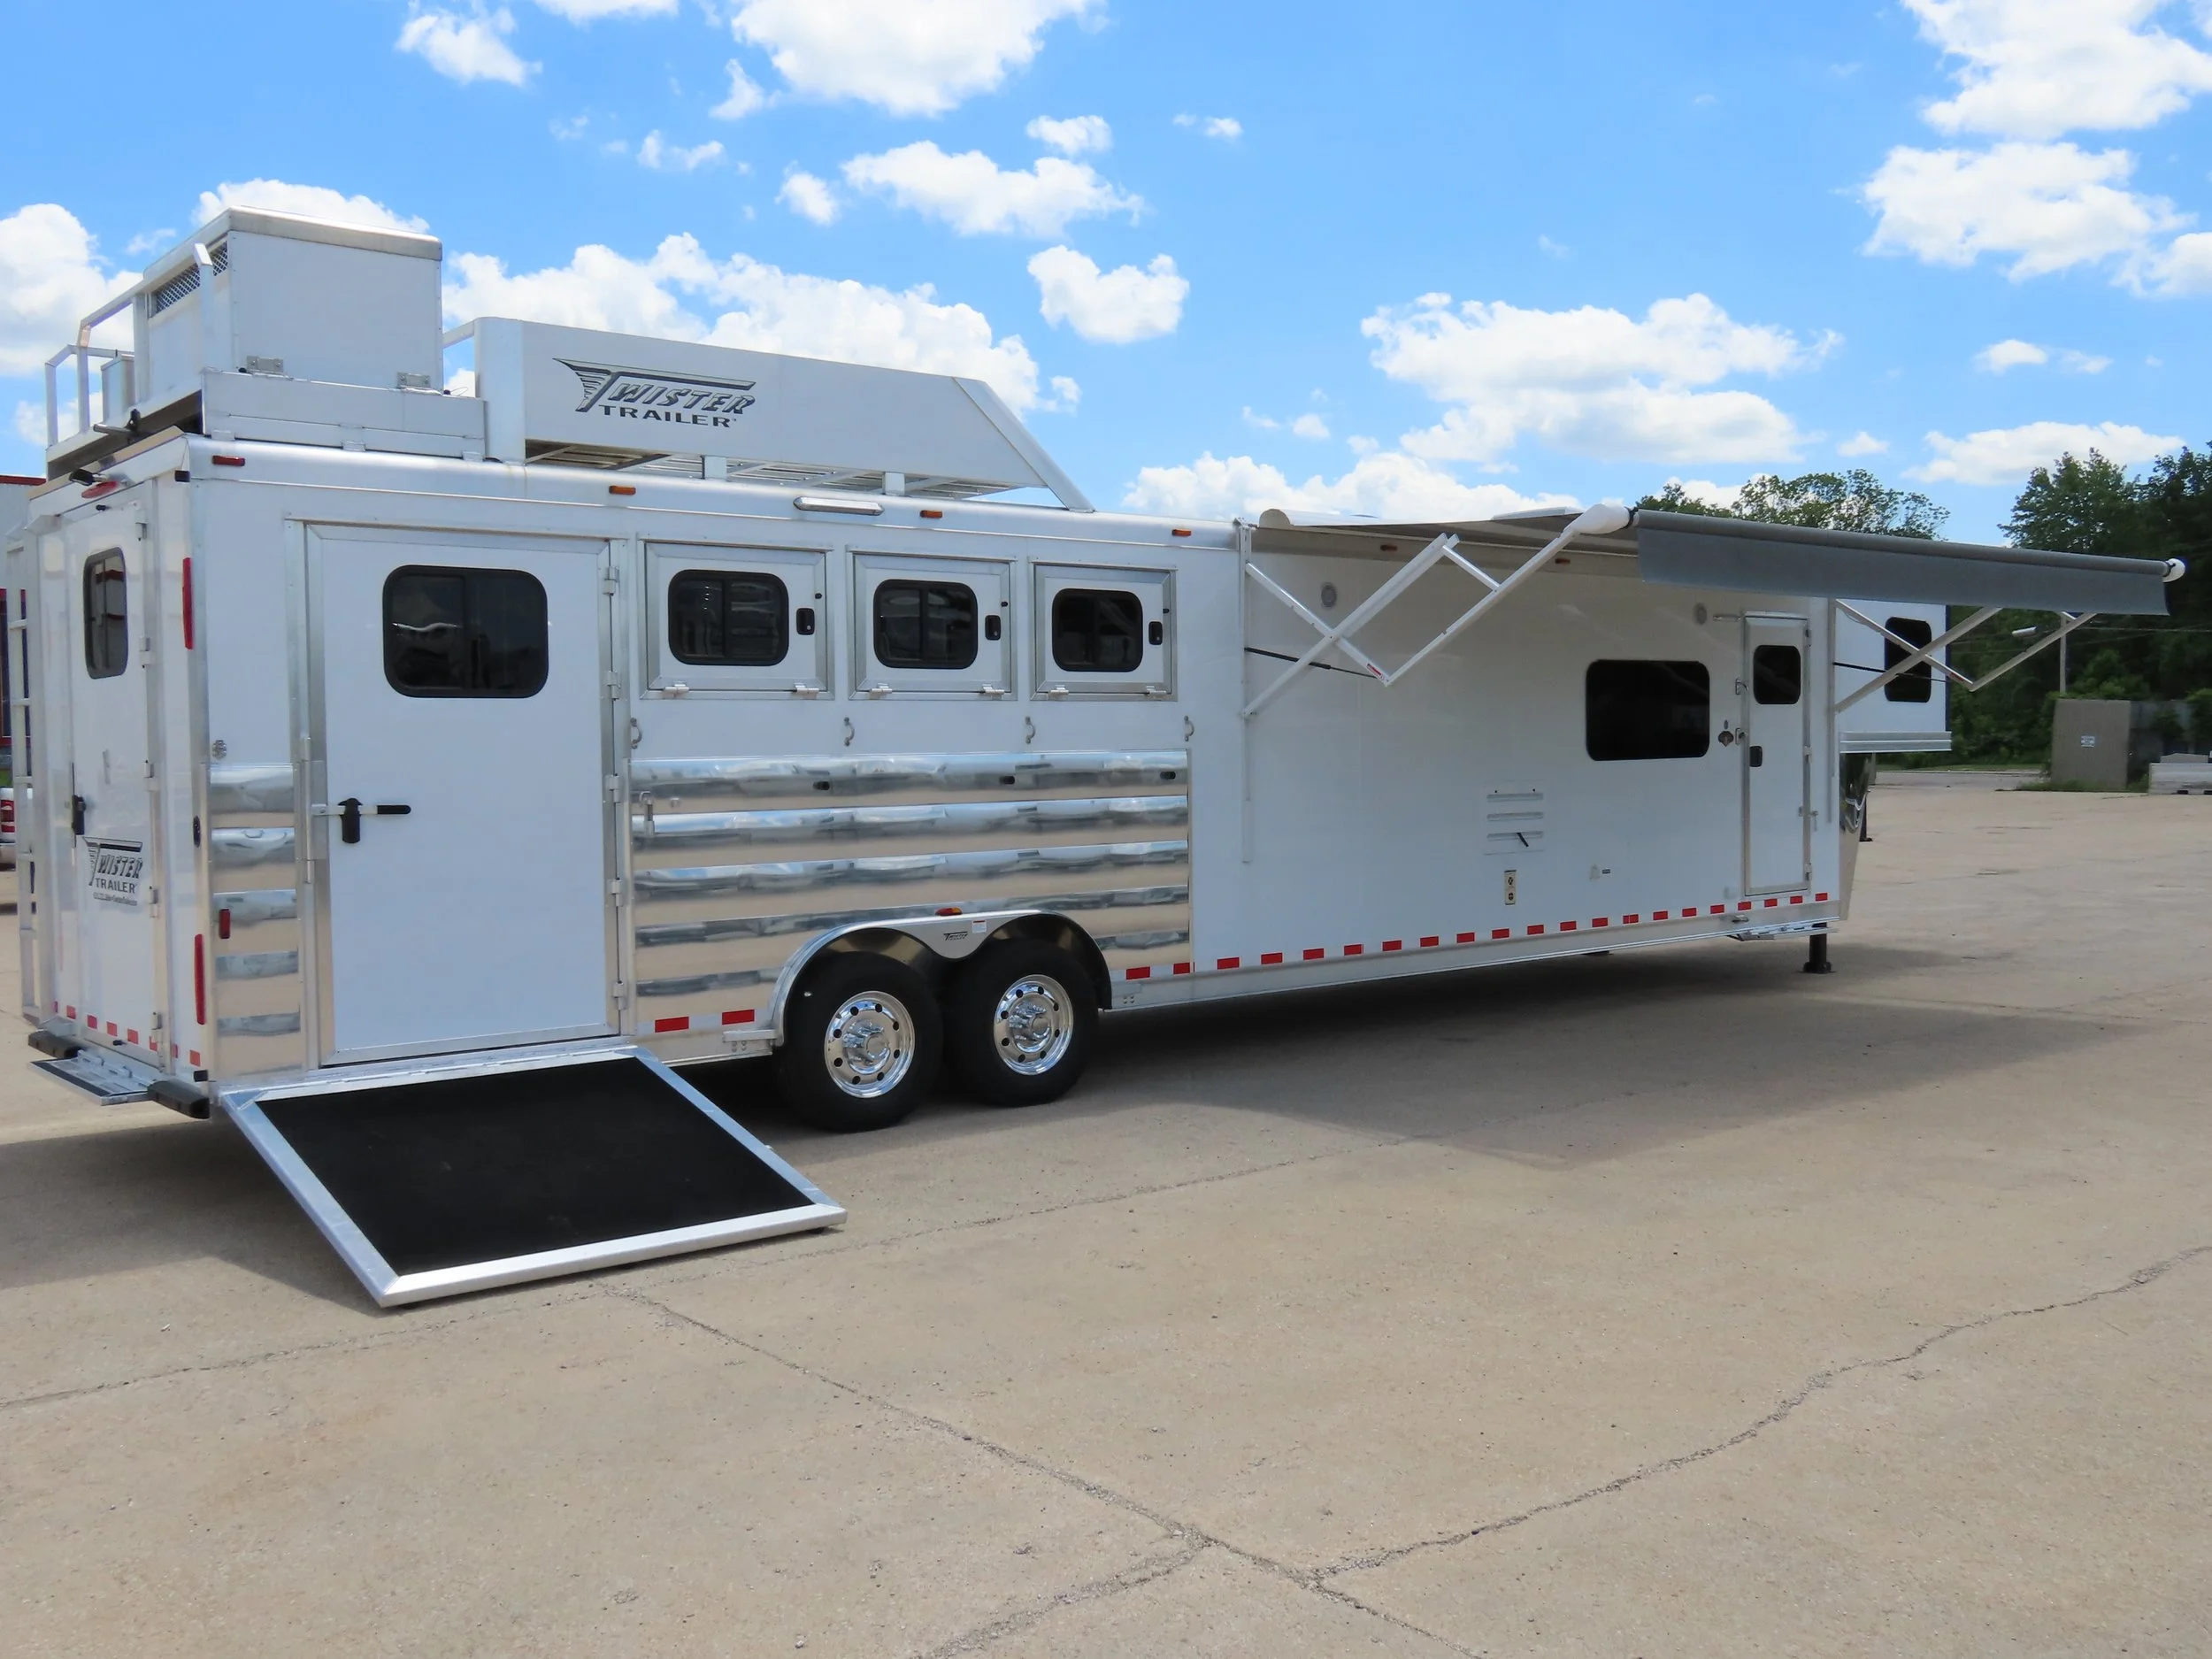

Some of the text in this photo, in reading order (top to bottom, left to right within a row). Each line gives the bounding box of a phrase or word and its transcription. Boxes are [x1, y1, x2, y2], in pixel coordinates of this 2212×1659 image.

[552, 357, 757, 414] TWISTER
[598, 404, 732, 427] TRAILER
[96, 878, 135, 893] TRAILER
